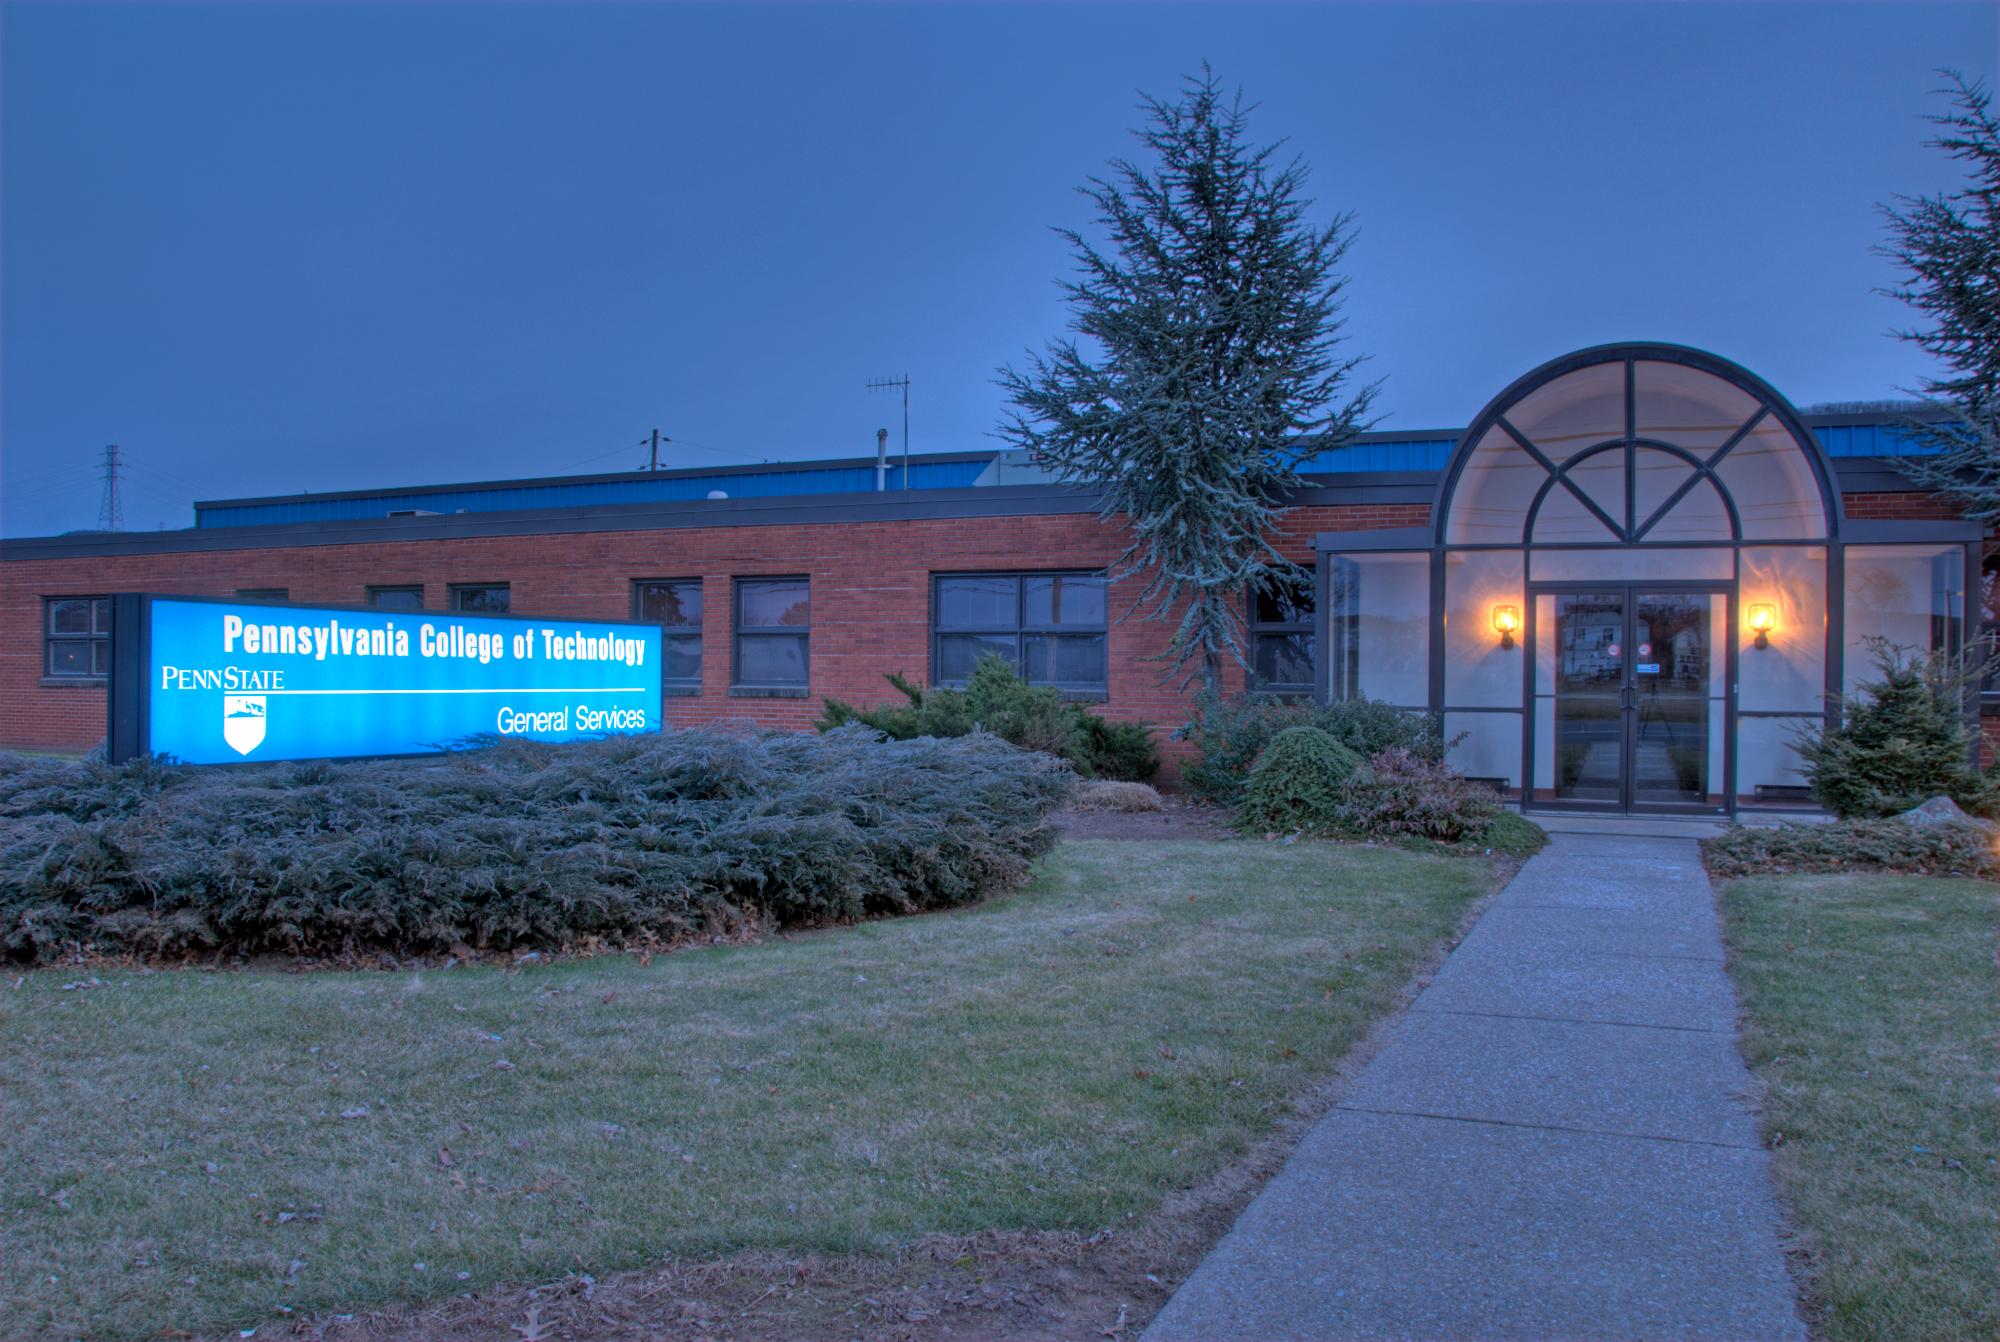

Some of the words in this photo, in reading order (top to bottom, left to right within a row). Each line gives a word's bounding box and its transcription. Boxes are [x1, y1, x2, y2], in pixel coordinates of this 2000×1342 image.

[223, 614, 409, 661] Pennsylvania
[420, 623, 504, 665] College
[513, 628, 534, 656] of
[542, 629, 646, 667] Technology
[497, 705, 569, 735] General
[575, 704, 646, 731] Services
